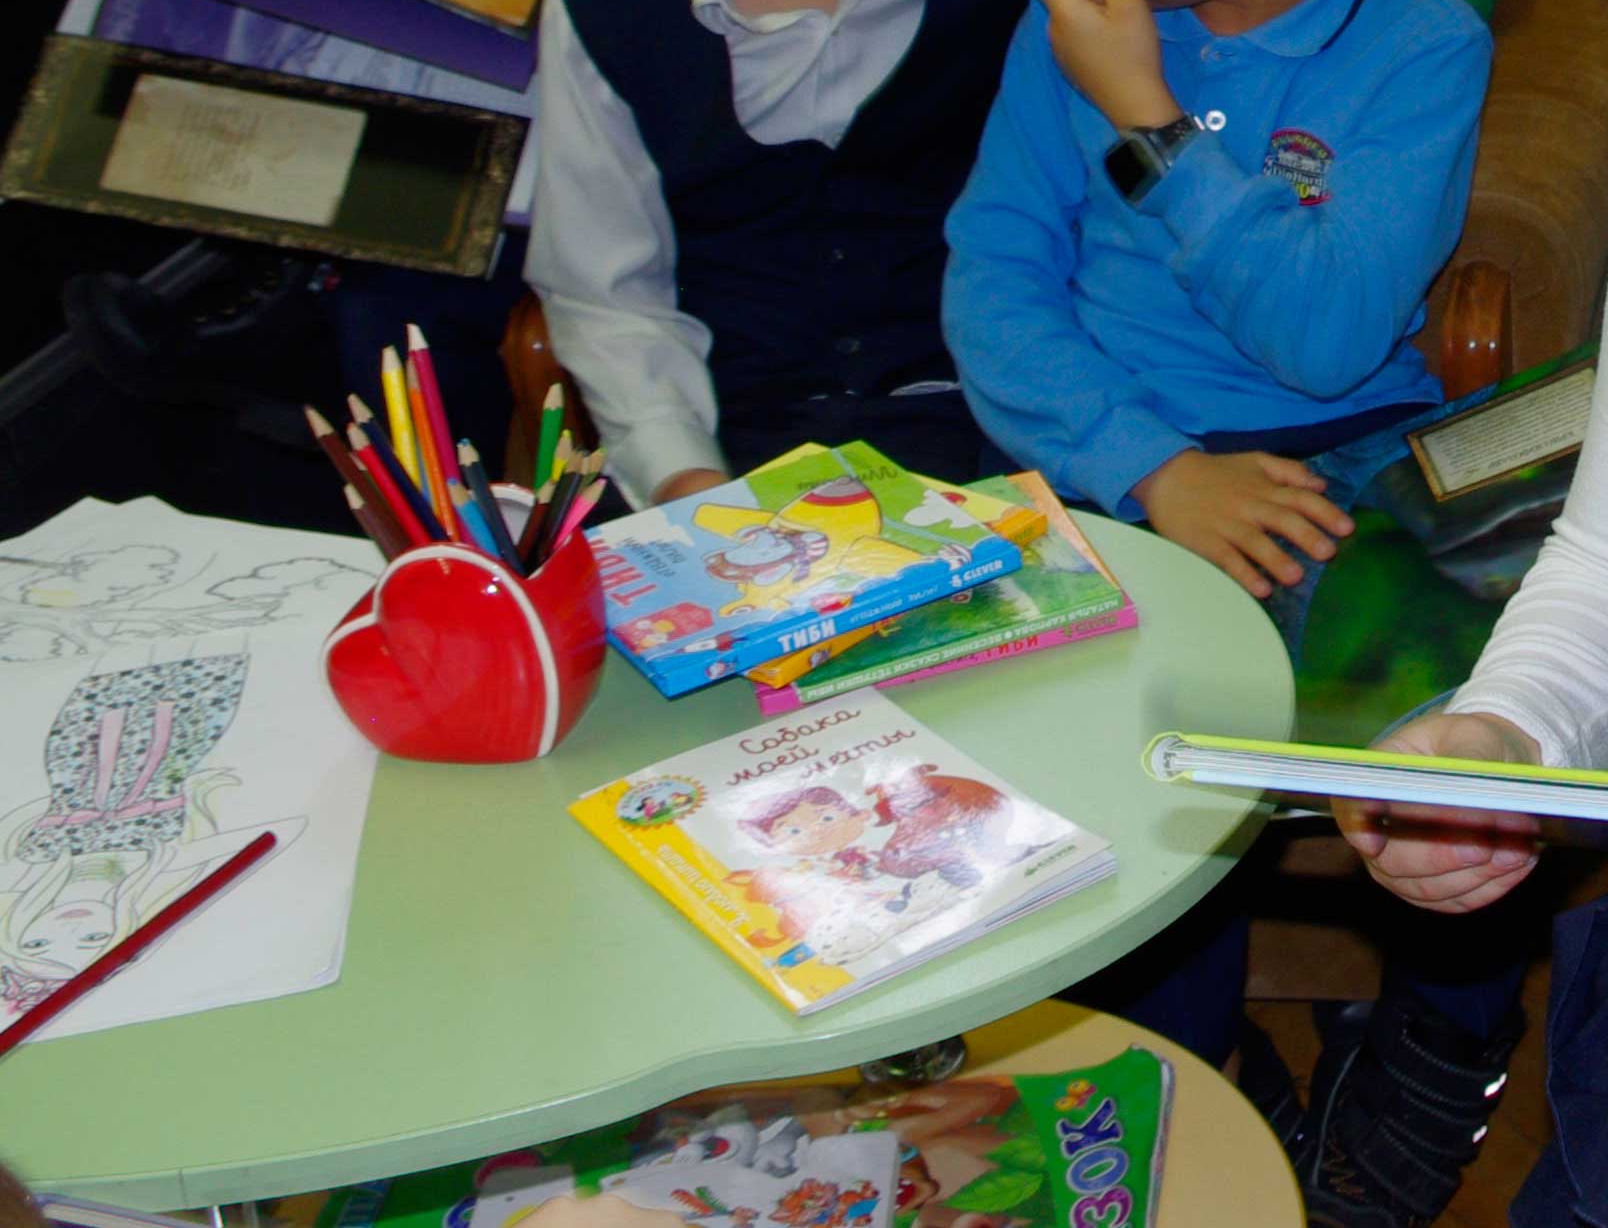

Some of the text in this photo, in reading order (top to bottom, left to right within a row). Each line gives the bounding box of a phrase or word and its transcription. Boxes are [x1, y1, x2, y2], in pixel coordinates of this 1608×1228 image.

[963, 559, 1003, 582] CLEVER
[1068, 598, 1119, 619] НАТАЛЬЯ
[777, 619, 836, 652] ТИБИ
[1014, 613, 1066, 637] КАРПОВА
[894, 649, 942, 672] СКАЗКИ
[738, 709, 861, 754] Собака
[727, 744, 819, 785] моей
[800, 729, 916, 779] мечты
